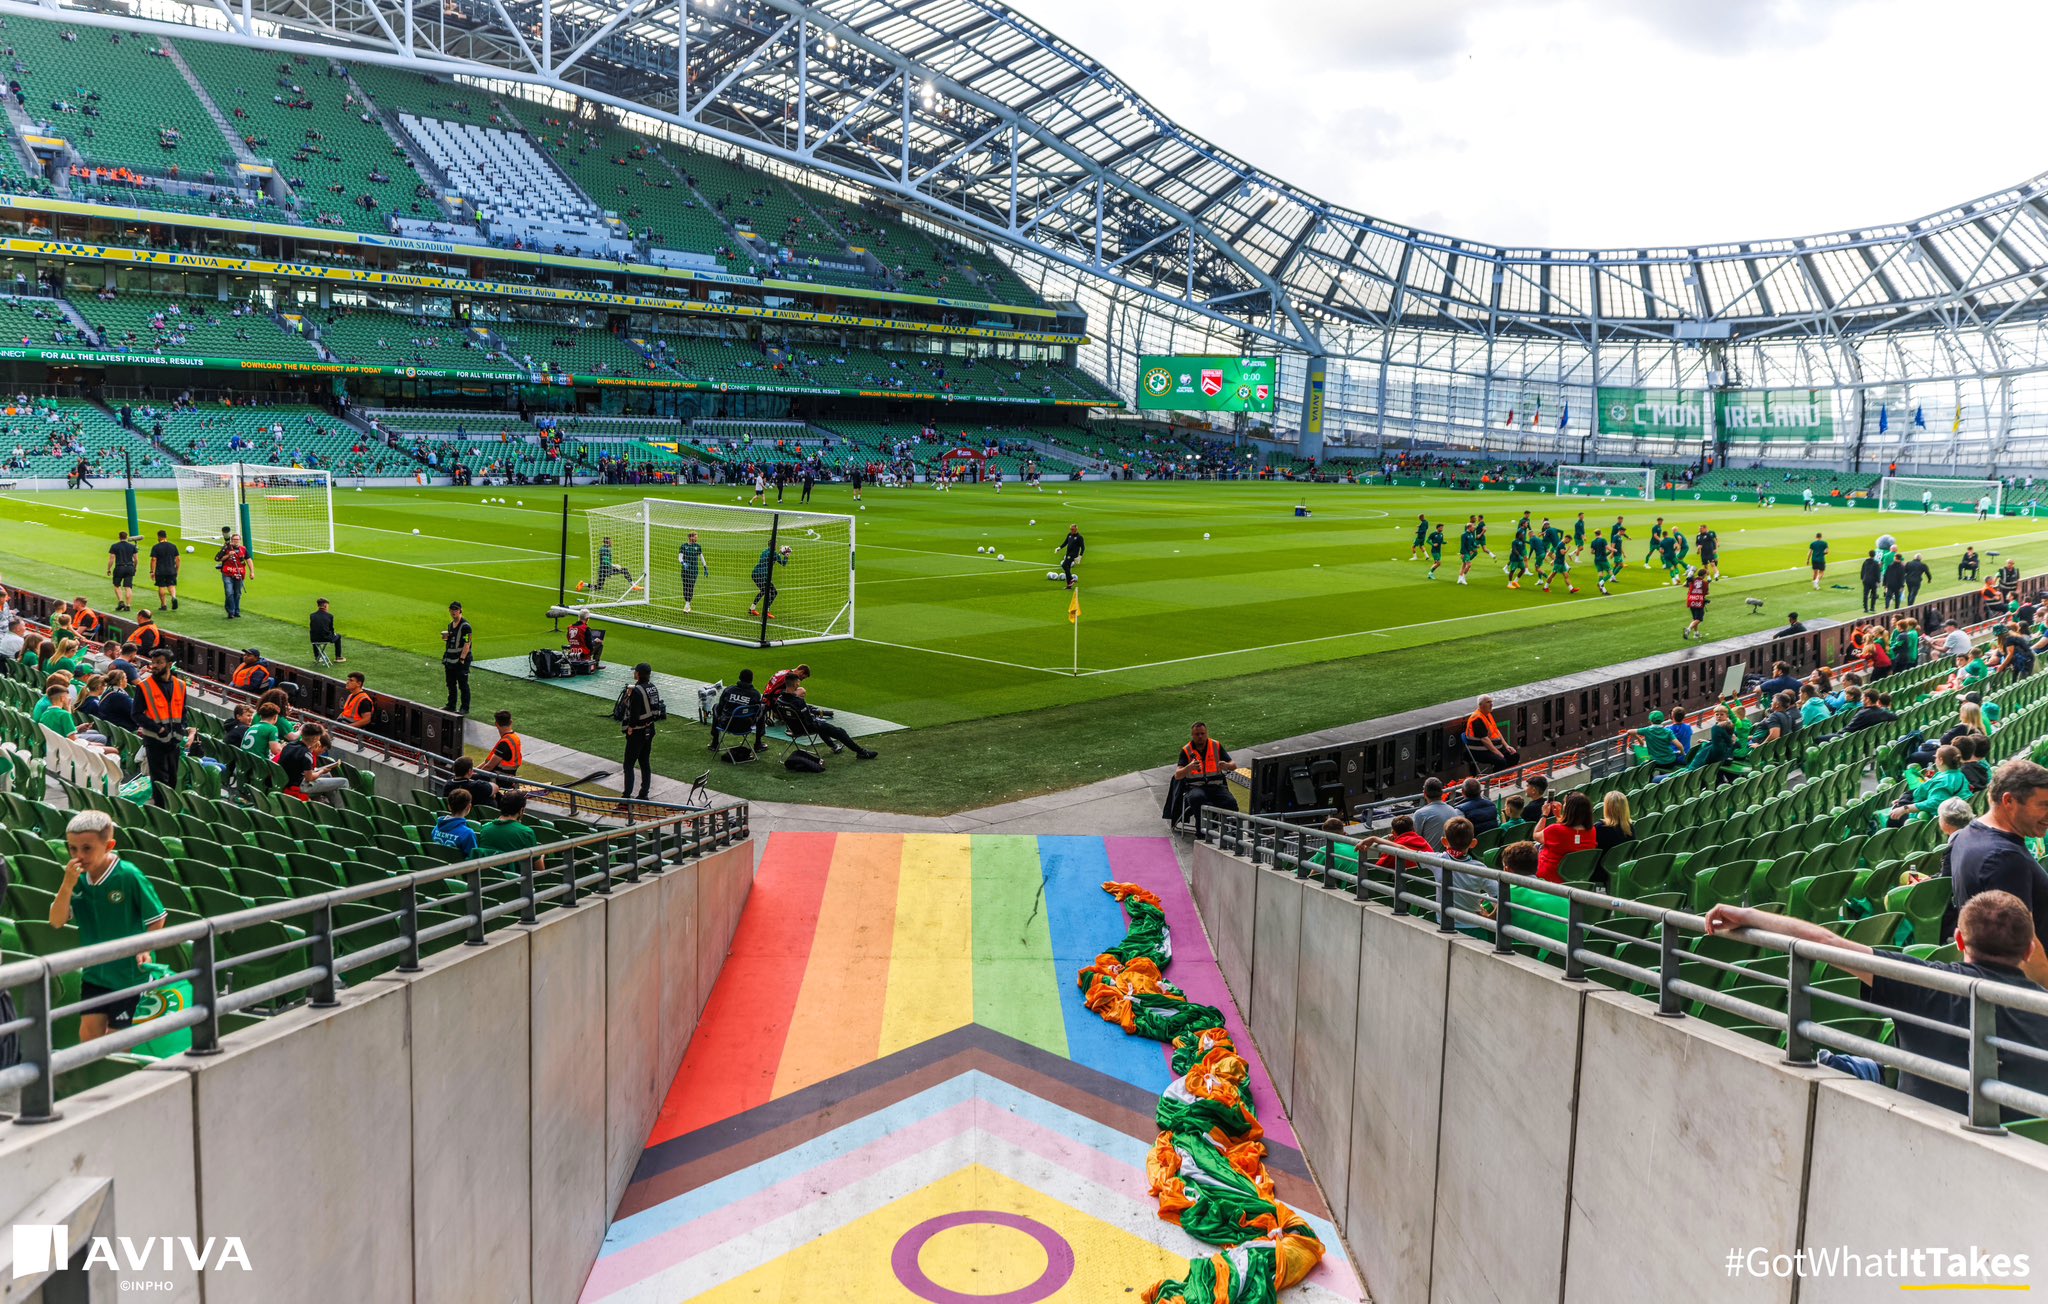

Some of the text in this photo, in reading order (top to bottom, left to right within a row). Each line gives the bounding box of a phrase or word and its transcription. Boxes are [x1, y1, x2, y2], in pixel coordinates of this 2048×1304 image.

[388, 239, 453, 252] AVIVA STADIUM
[182, 256, 218, 267] AVIVA
[391, 275, 422, 285] AVIVA
[716, 275, 734, 283] AVIVA
[503, 286, 556, 298] It takes Aviva
[643, 299, 666, 307] AVIVA
[779, 311, 800, 319] AVIVA
[897, 322, 916, 330] AVIVA
[78, 353, 94, 361] THE
[96, 354, 125, 362] LATEST
[127, 356, 168, 365] FIXTURES,
[170, 357, 204, 366] RESULTS
[241, 362, 282, 370] DOWNLOAD
[312, 364, 344, 372] CONNECT
[1312, 394, 1320, 422] AVIVA
[1634, 403, 1820, 428] C'MON IRELAND
[730, 694, 750, 704] PULSE
[242, 730, 258, 750] 5
